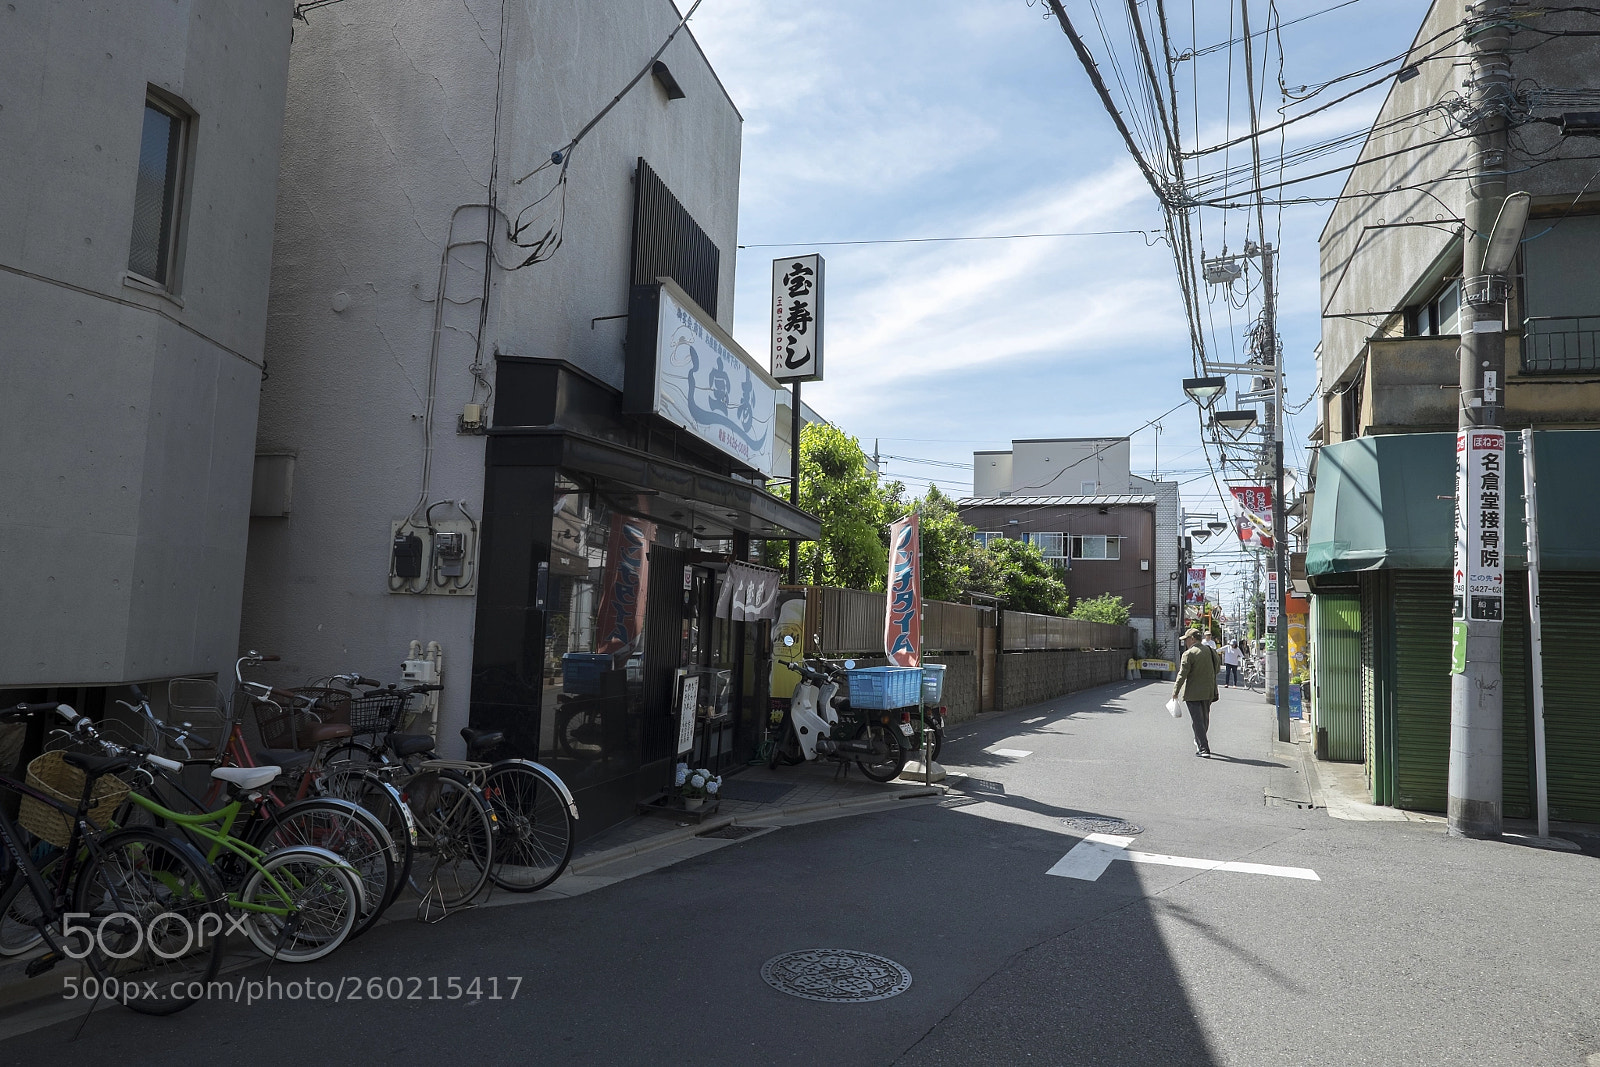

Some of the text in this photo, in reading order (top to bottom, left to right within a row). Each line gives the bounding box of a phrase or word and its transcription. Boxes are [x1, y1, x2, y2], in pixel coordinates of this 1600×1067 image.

[783, 262, 814, 370] 宝寿し
[1480, 452, 1500, 568] 名倉堂接骨院
[1470, 574, 1493, 582] この先
